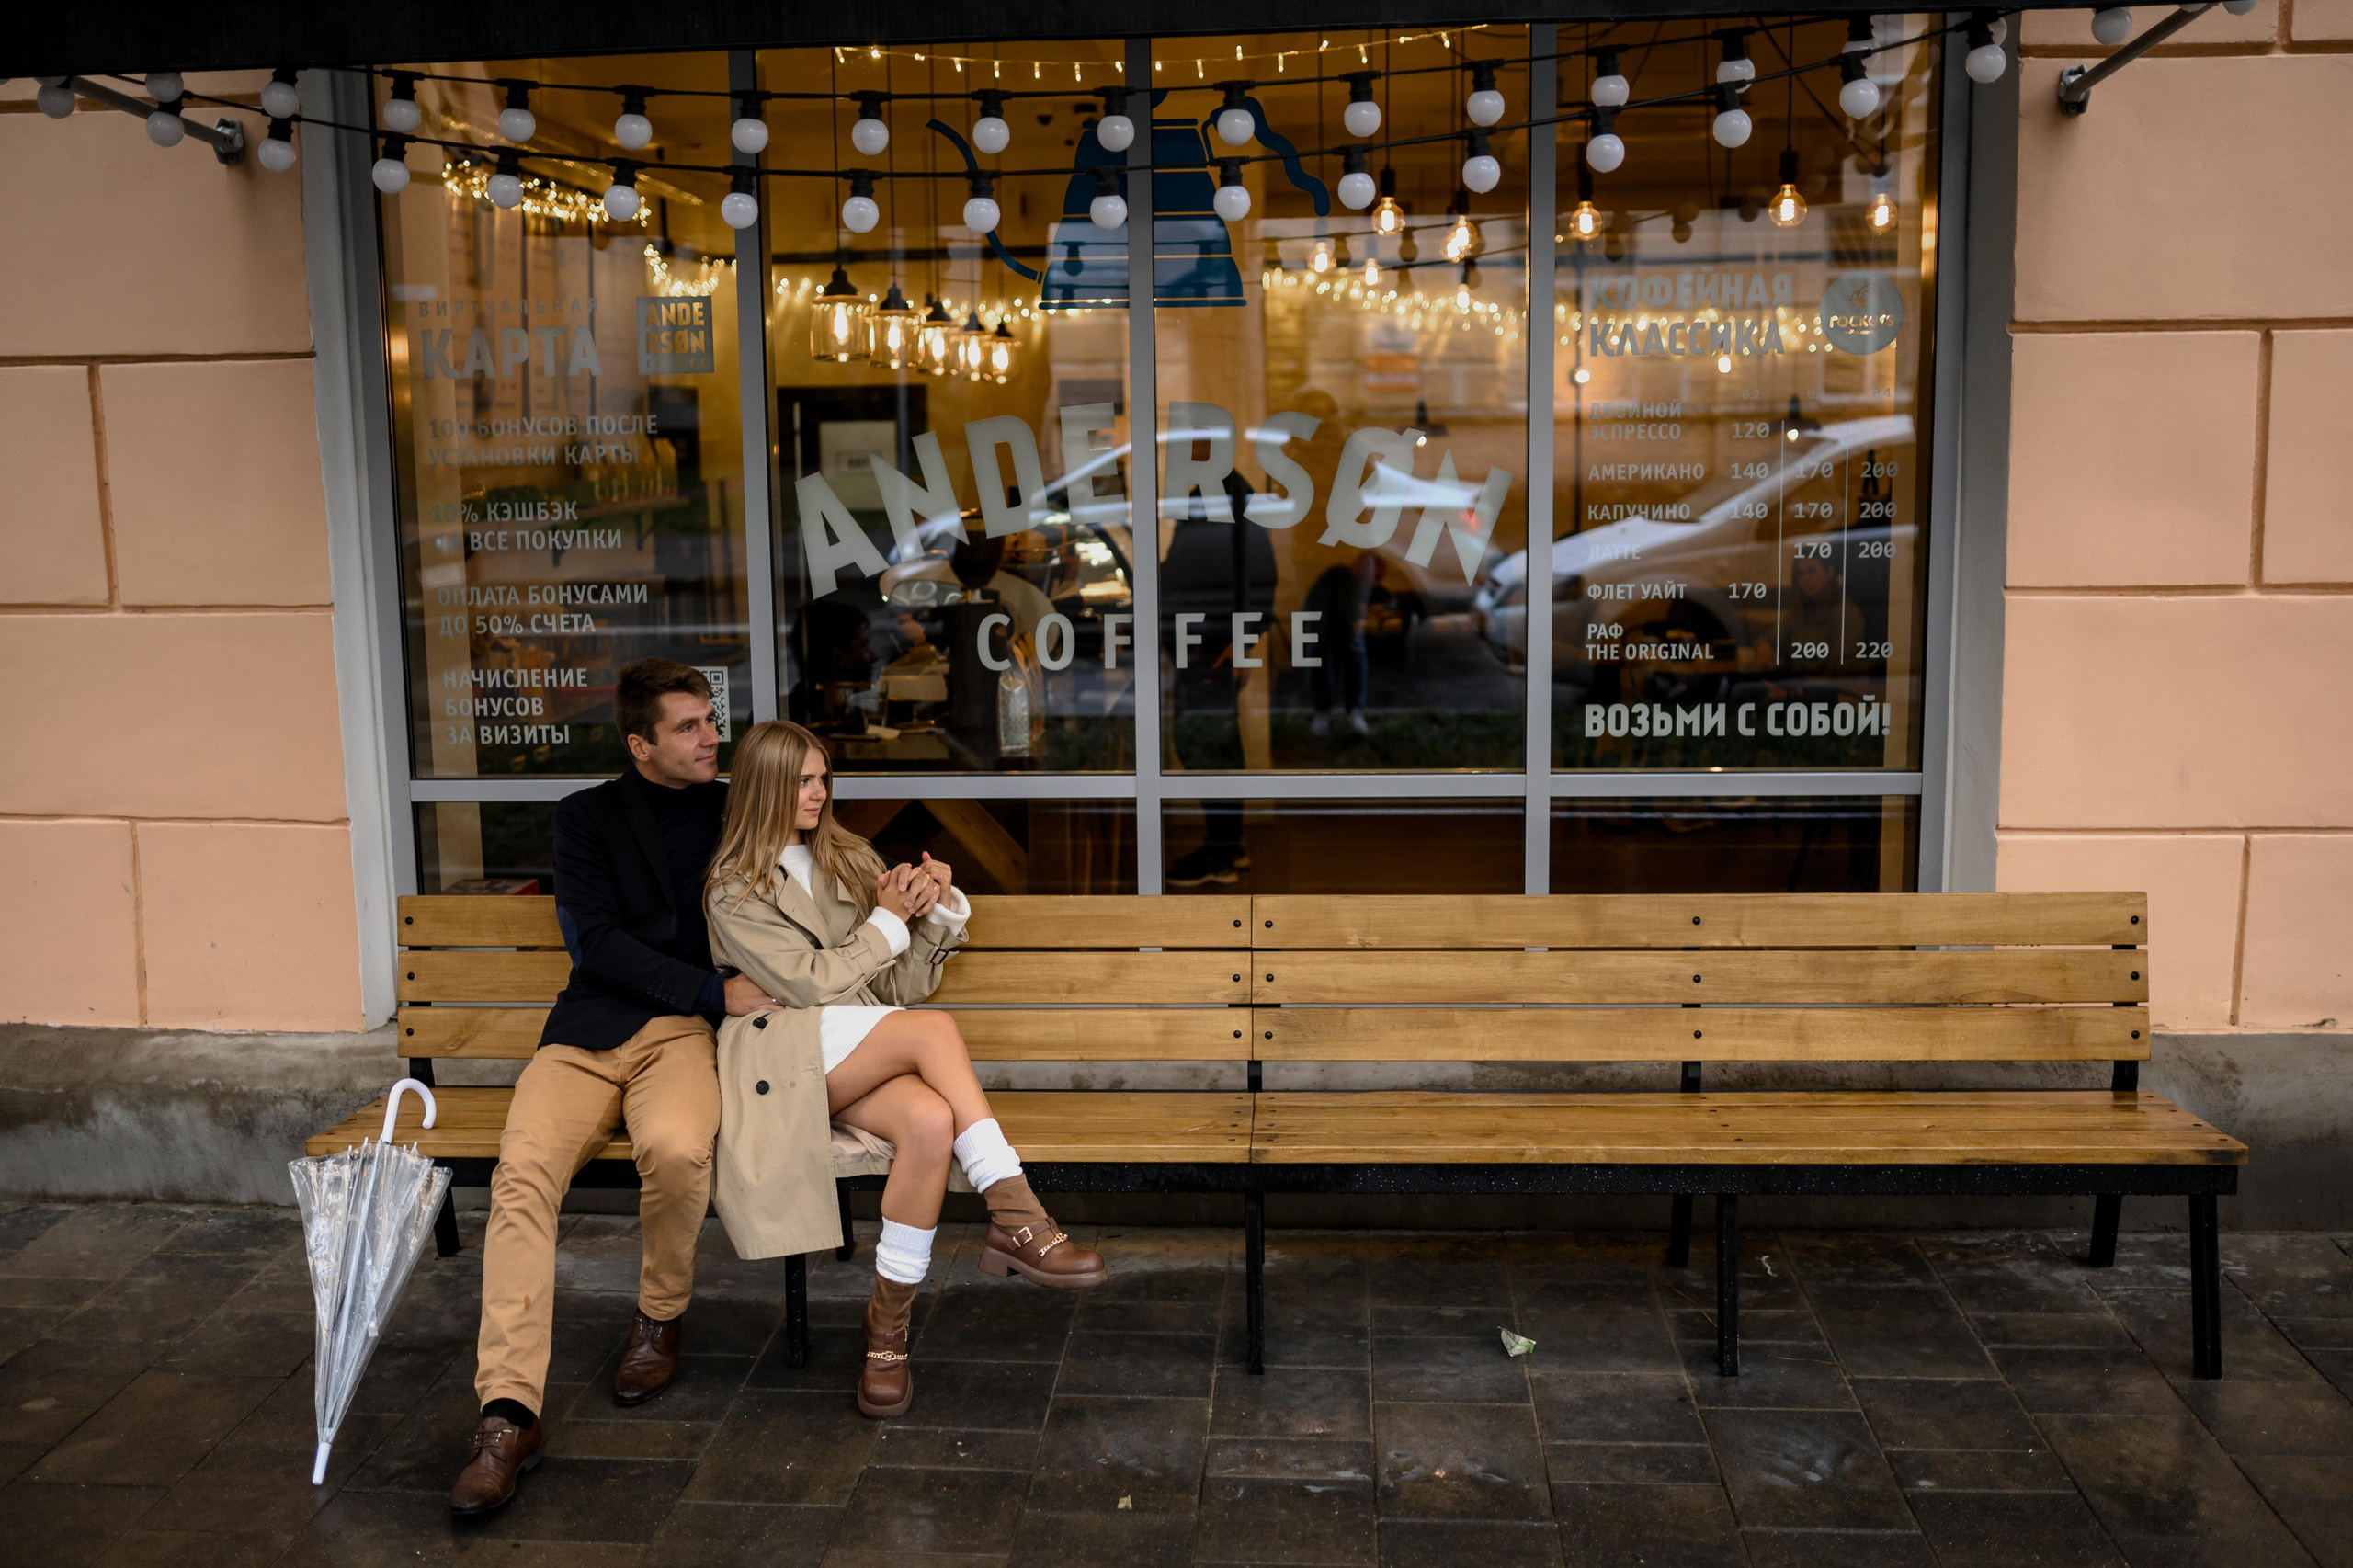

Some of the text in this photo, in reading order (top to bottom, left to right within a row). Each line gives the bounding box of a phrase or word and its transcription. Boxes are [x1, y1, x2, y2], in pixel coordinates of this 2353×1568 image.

[1590, 267, 1793, 310] КОФЕЙНАЯ
[418, 296, 598, 318] ВИРТУАЛЬНАЯ
[645, 301, 705, 327] ANDE
[1590, 320, 1785, 358] КЛАССИКА
[420, 324, 605, 381] КАРТА
[1589, 399, 1682, 421] ДВОЙНОЙ
[428, 414, 658, 439] 100 БОНУСОВ ПОСЛЕ
[1588, 422, 1770, 441] ЭСПРЕССО 120
[428, 444, 640, 469] УСТАНОВКИ КАРТЫ
[1588, 460, 1900, 482] АМЕРИКАНО 140 170 200
[793, 401, 1514, 599] ANDERSØN
[1587, 501, 1898, 521] КАПУЧИНО 140 170 200
[431, 500, 579, 524] 10% КЭШБЭК
[470, 530, 509, 551] ВСЕ
[516, 528, 623, 551] ПОКУПКИ
[1588, 541, 1897, 562] ЛАТТЕ 170 200
[437, 584, 649, 608] ОПЛАТА БОНУСАМИ
[1587, 580, 1768, 601] ФЛЕТ УАЙТ 170
[438, 613, 597, 640] ДО 50% СЧЕТА
[1586, 622, 1624, 640] РАФ
[977, 611, 1323, 672] COFFEE
[1586, 642, 1894, 661] THE ORIGINAL 200 220
[442, 666, 588, 689] НАЧИСЛЕНИЕ
[445, 697, 544, 718] БОНУСОВ
[1585, 694, 1893, 738] ВОЗЬМИ С СОБОЙ!
[446, 724, 571, 746] ЗА ВИЗИТЫ
